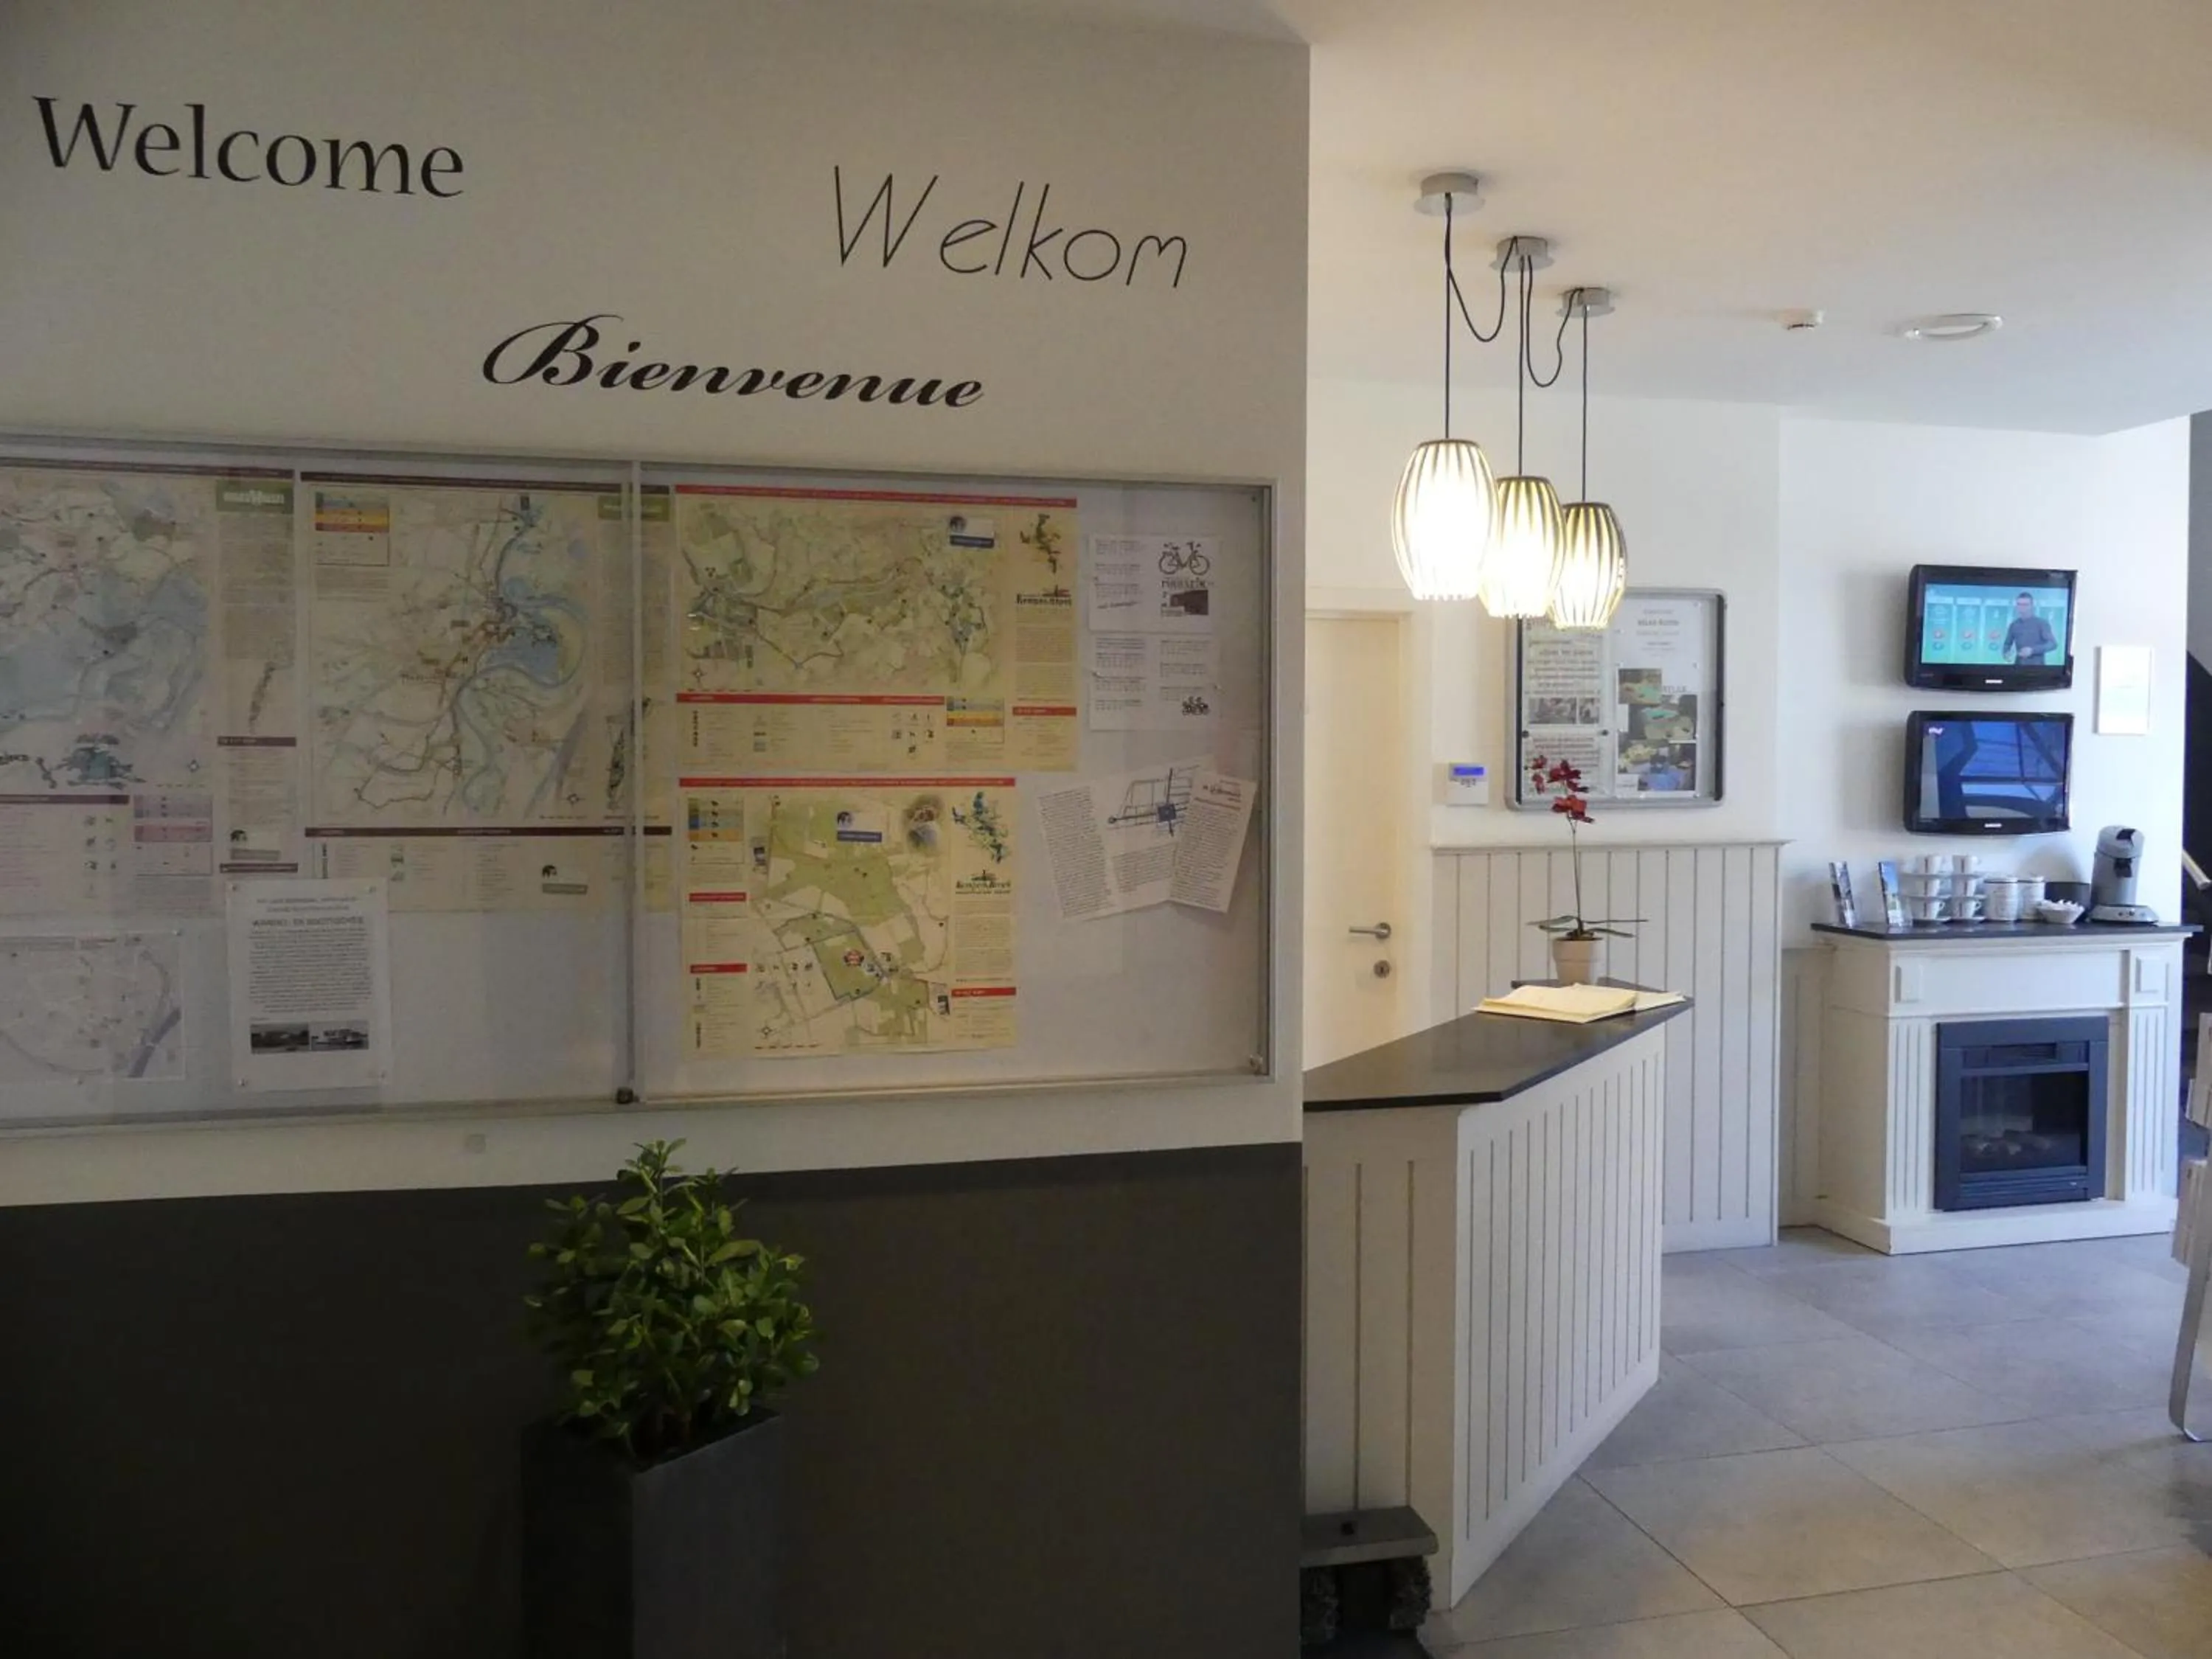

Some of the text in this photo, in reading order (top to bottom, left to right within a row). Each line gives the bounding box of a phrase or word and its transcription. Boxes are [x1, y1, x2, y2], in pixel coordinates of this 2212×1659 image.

[31, 96, 463, 198] Welcome
[835, 165, 1186, 288] Welkom
[483, 315, 983, 407] Bienvenue
